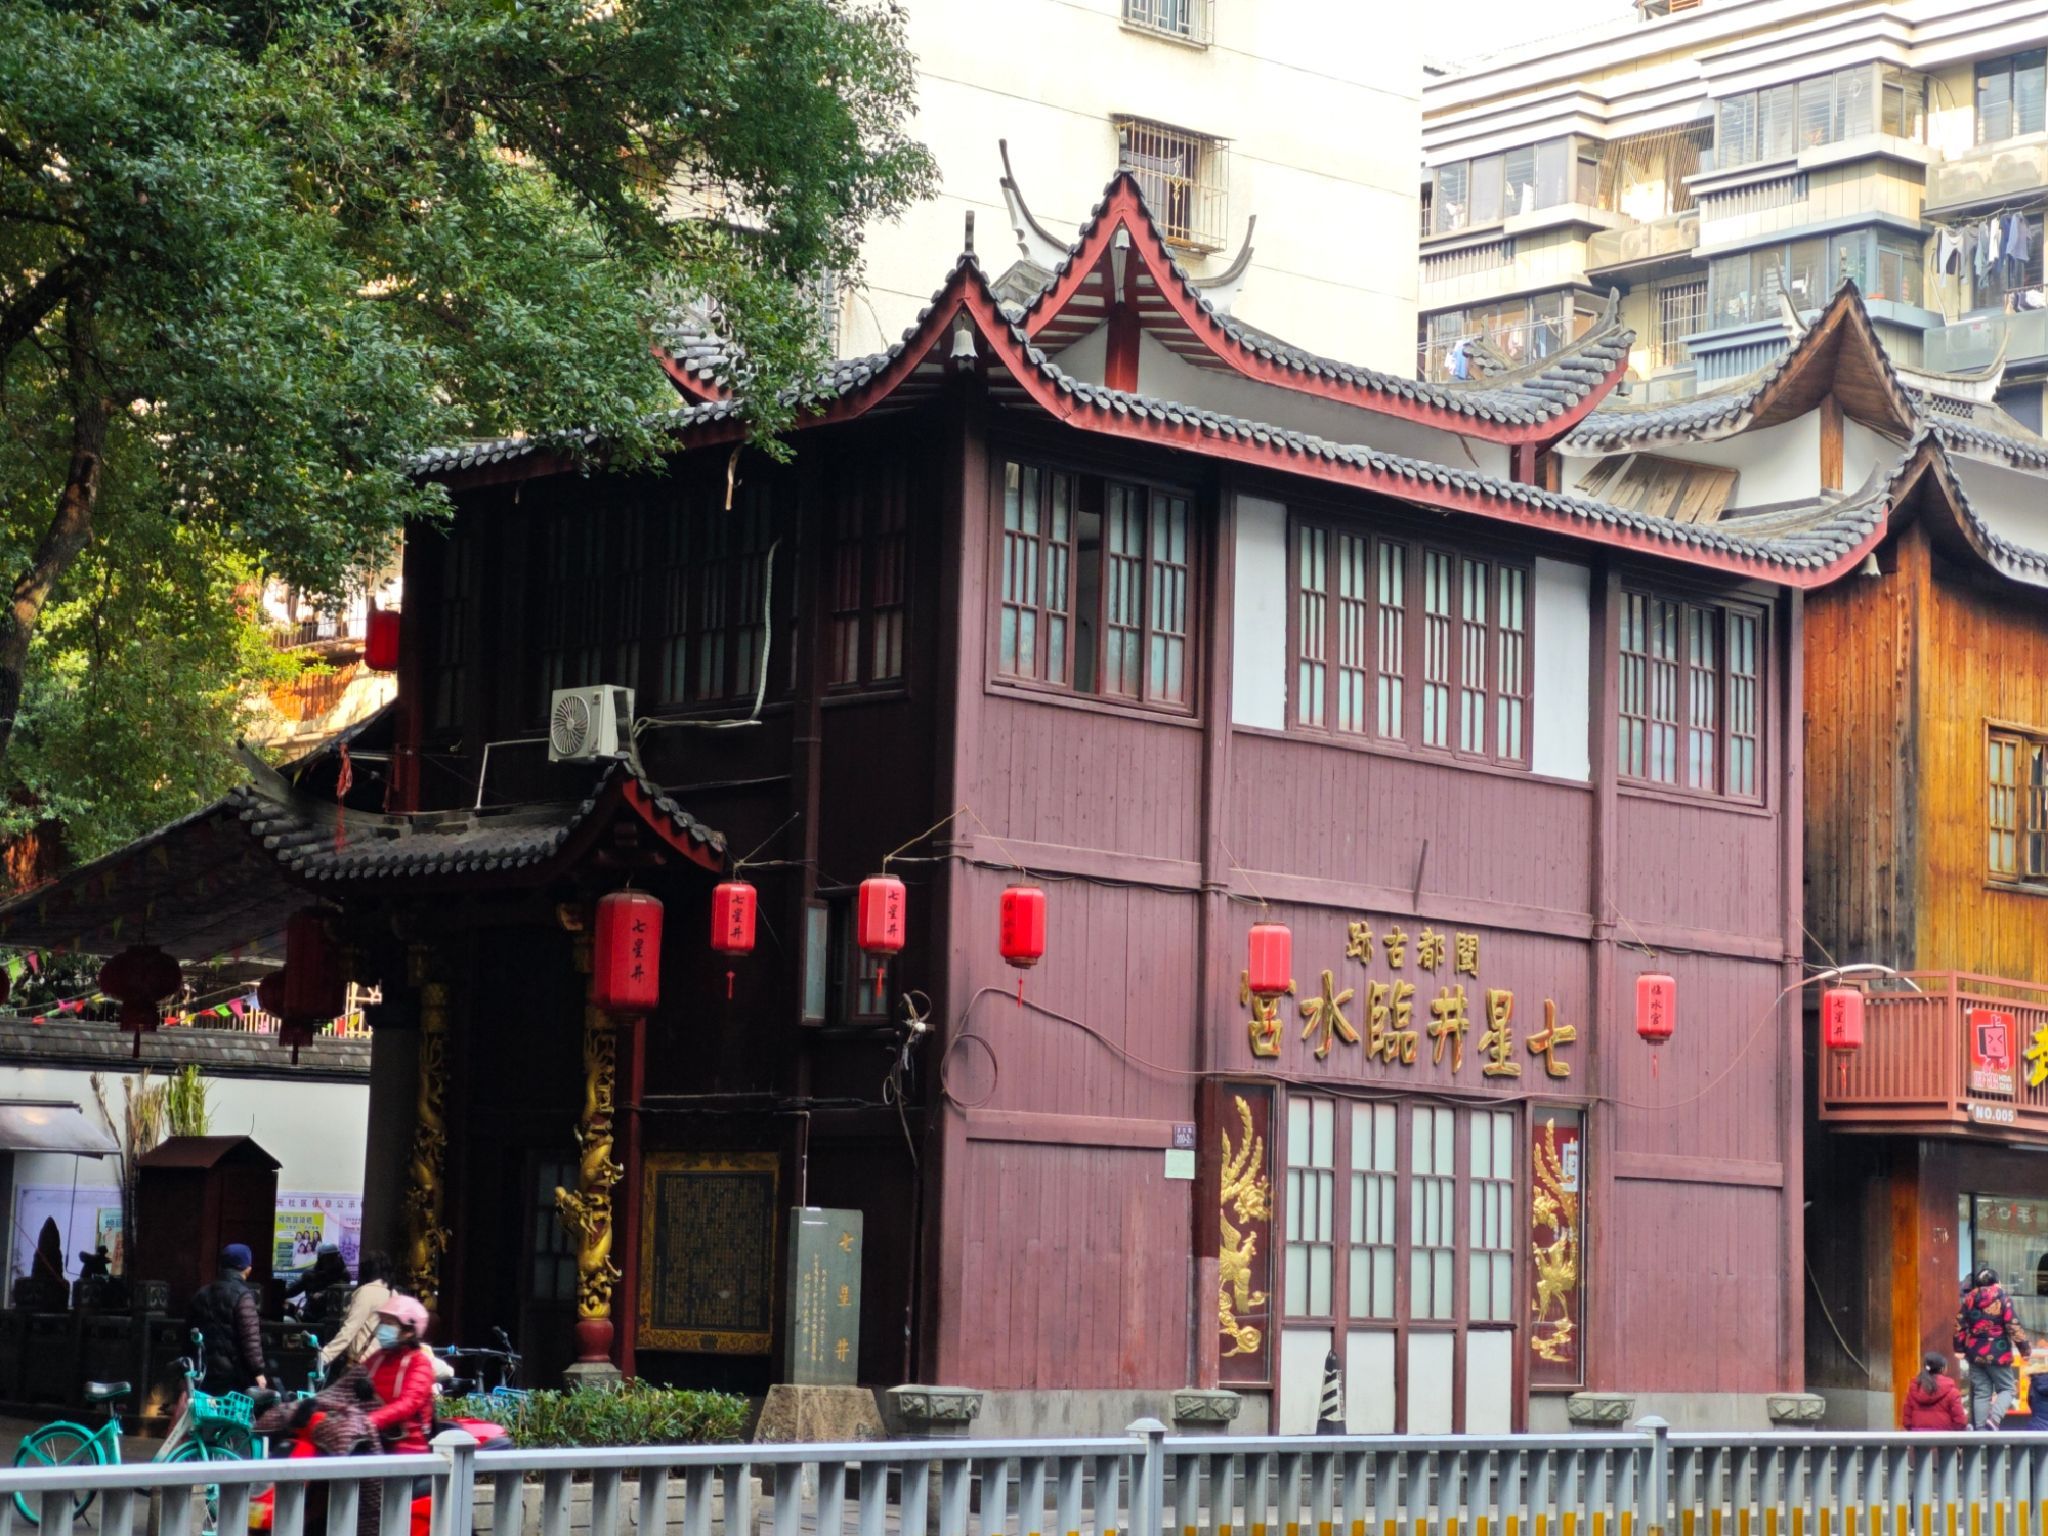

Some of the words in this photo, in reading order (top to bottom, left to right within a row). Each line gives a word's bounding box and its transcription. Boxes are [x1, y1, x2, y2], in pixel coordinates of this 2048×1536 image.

[730, 894, 745, 940] 七星井
[887, 890, 900, 937] 七星井
[631, 919, 648, 983] 七星井
